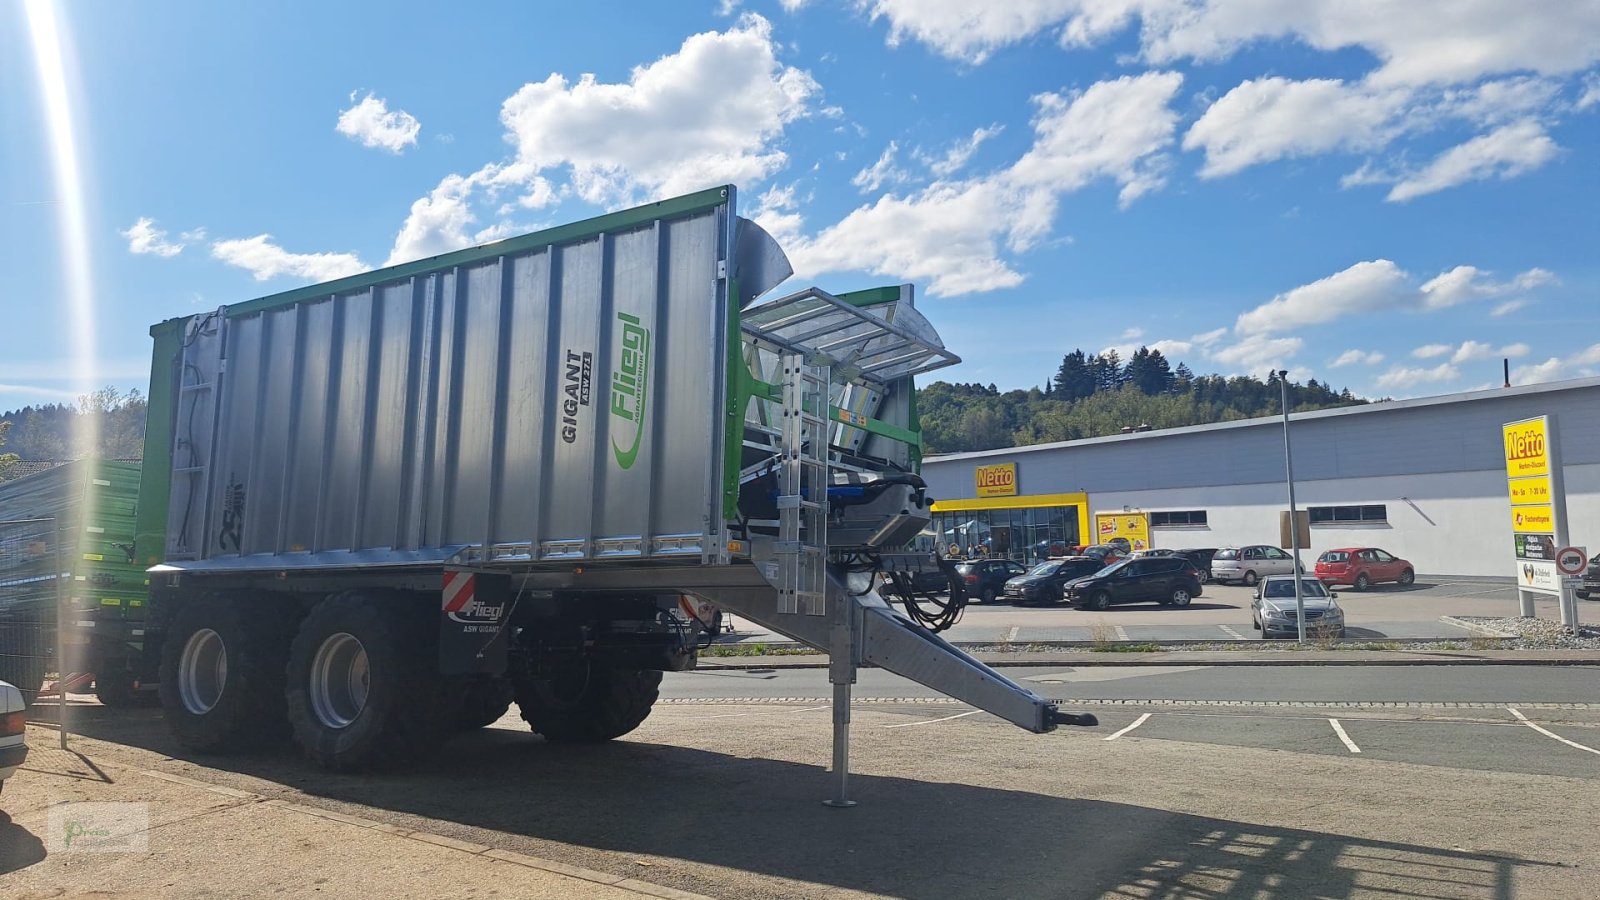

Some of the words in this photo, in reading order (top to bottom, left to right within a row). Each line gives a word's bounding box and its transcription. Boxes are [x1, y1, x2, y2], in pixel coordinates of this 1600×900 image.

[583, 356, 591, 377] 271
[611, 311, 645, 420] Fliegl
[562, 349, 581, 443] GIGANT
[581, 379, 590, 402] ASW
[634, 354, 645, 425] AGRARTECHNIK
[1507, 431, 1545, 460] Netto
[977, 468, 1013, 487] Netto
[463, 625, 477, 633] ASW
